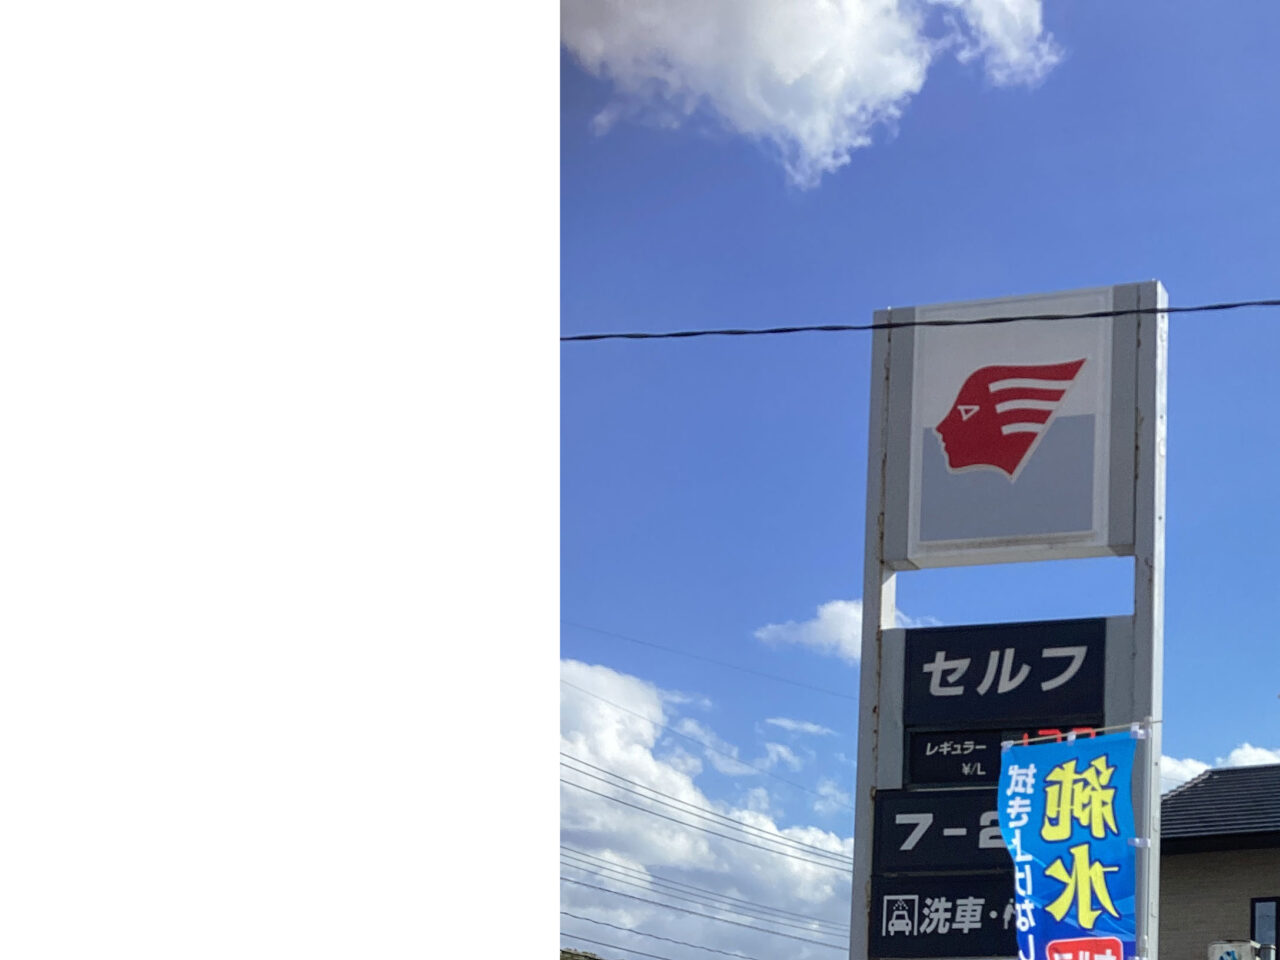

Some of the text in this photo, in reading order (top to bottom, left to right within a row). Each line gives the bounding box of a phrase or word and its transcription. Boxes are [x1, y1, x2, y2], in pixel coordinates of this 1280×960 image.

[923, 645, 1088, 696] セルフ
[926, 741, 987, 755] レギュラー
